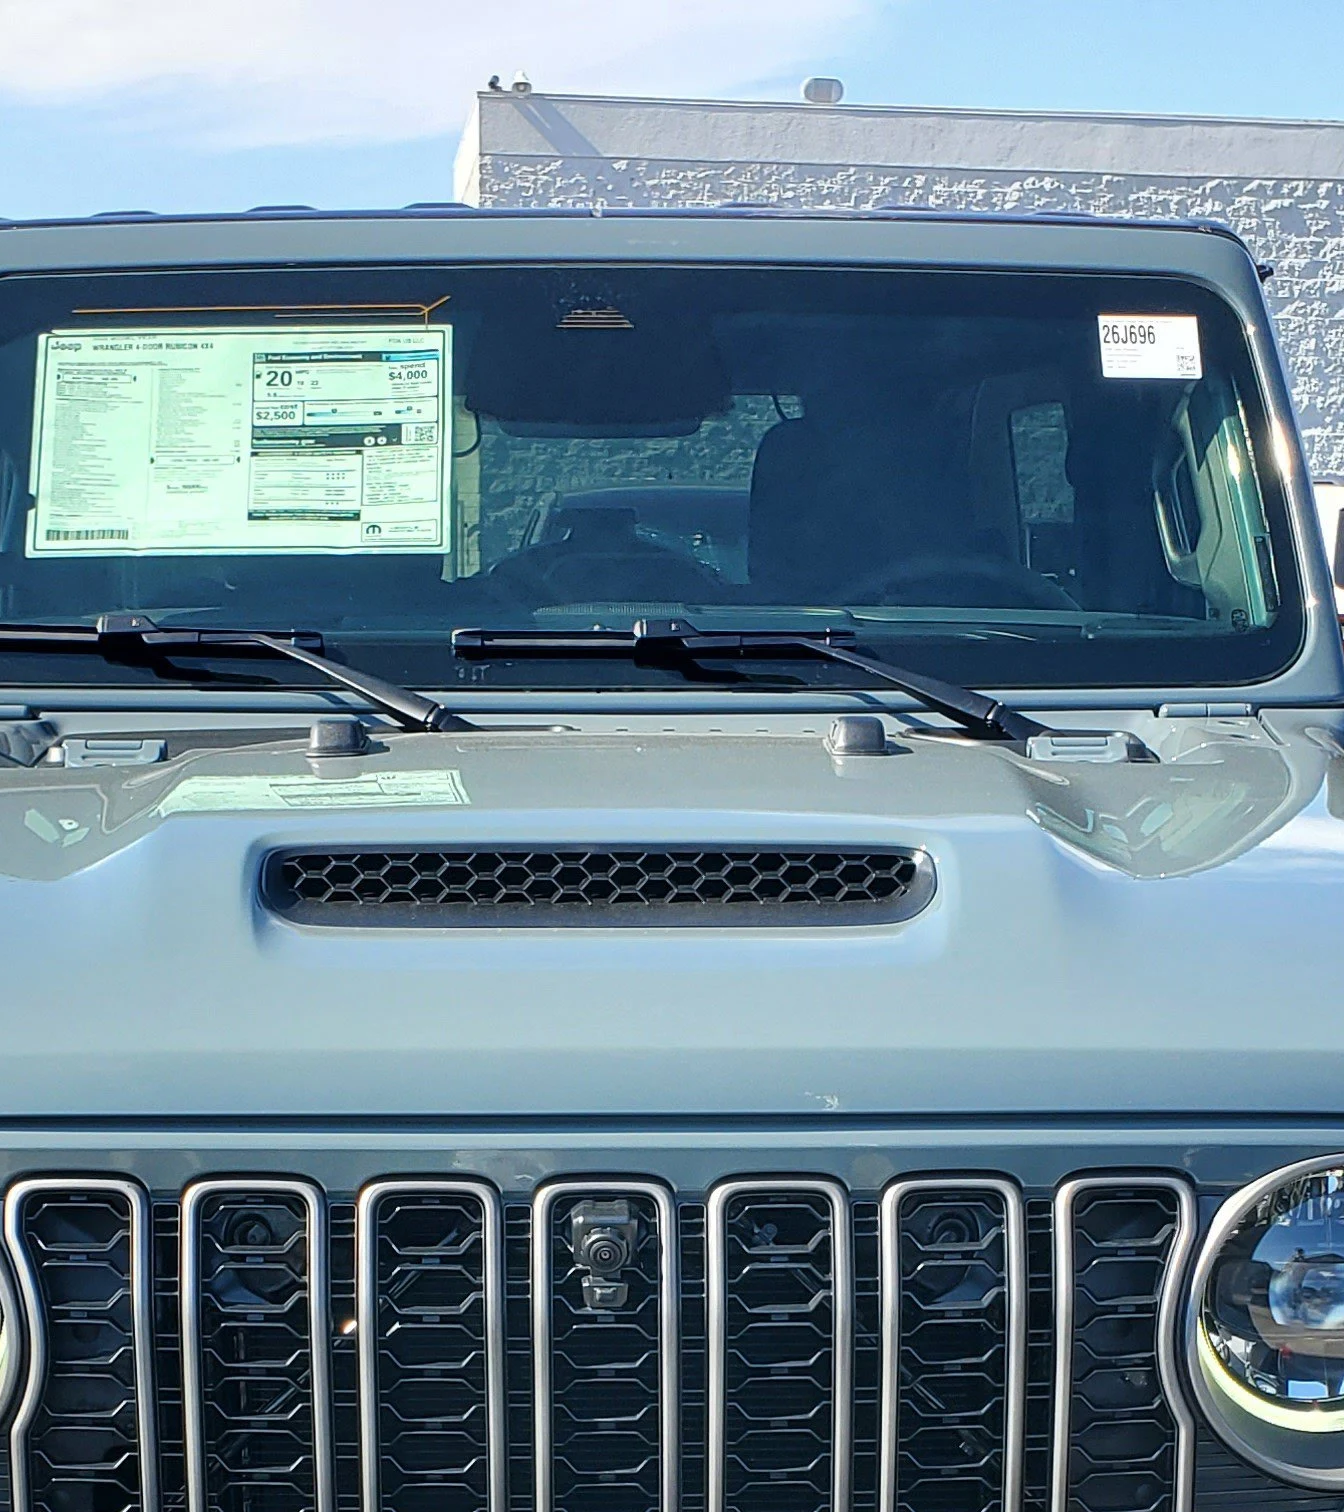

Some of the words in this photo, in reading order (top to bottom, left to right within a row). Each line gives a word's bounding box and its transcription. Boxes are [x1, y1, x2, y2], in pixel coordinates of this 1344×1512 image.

[1102, 324, 1156, 345] 26J696
[51, 341, 82, 352] Jeep
[92, 343, 133, 351] WRANGLER
[166, 342, 198, 350] RUBICON
[266, 370, 293, 387] 20
[388, 369, 428, 381] $4,000
[255, 410, 296, 421] $2,500
